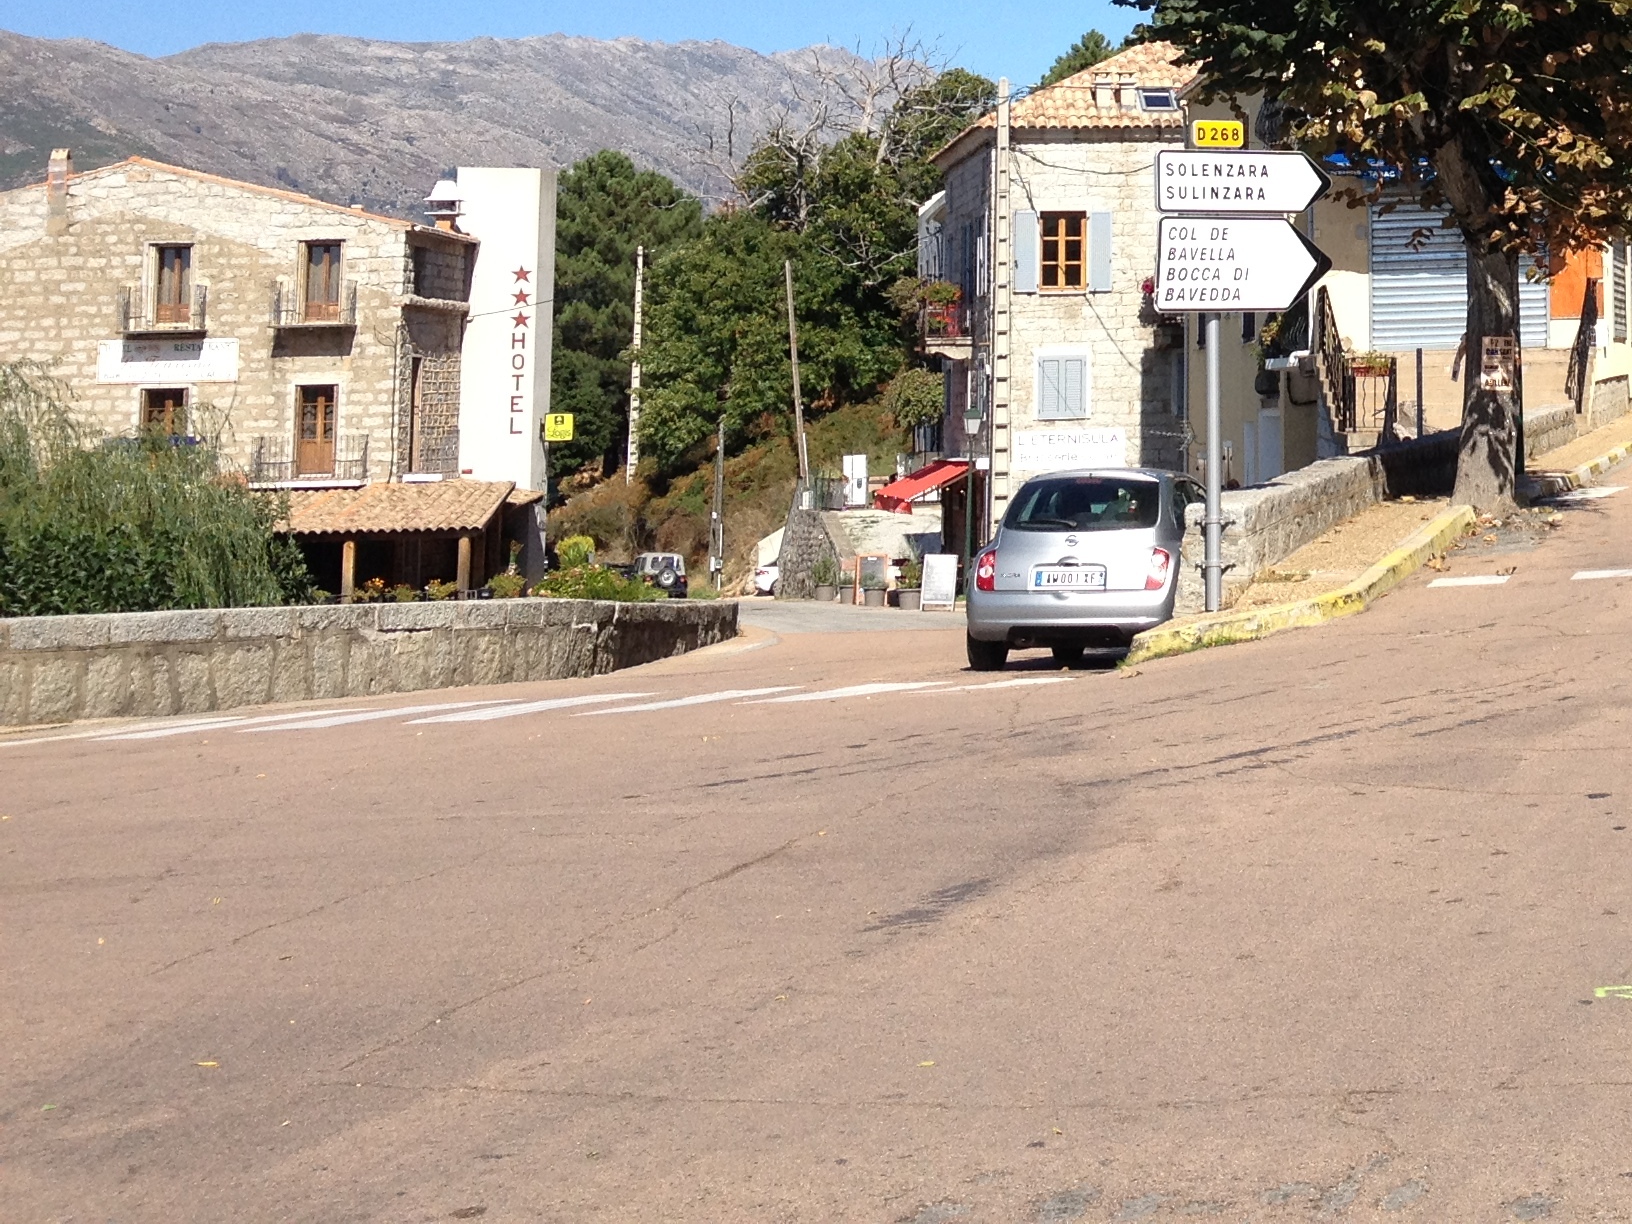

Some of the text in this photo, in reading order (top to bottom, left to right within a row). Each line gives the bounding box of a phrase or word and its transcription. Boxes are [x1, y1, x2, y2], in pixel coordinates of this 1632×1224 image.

[1197, 128, 1240, 141] D 268
[1166, 163, 1269, 178] SOLENZARA
[1166, 186, 1266, 201] SULINZARA
[1168, 227, 1229, 241] COL DE
[1167, 247, 1236, 261] BAVELLA
[1166, 268, 1249, 282] BOCCA DI
[1165, 288, 1241, 302] BAVEDDA
[510, 332, 526, 435] HOTEL
